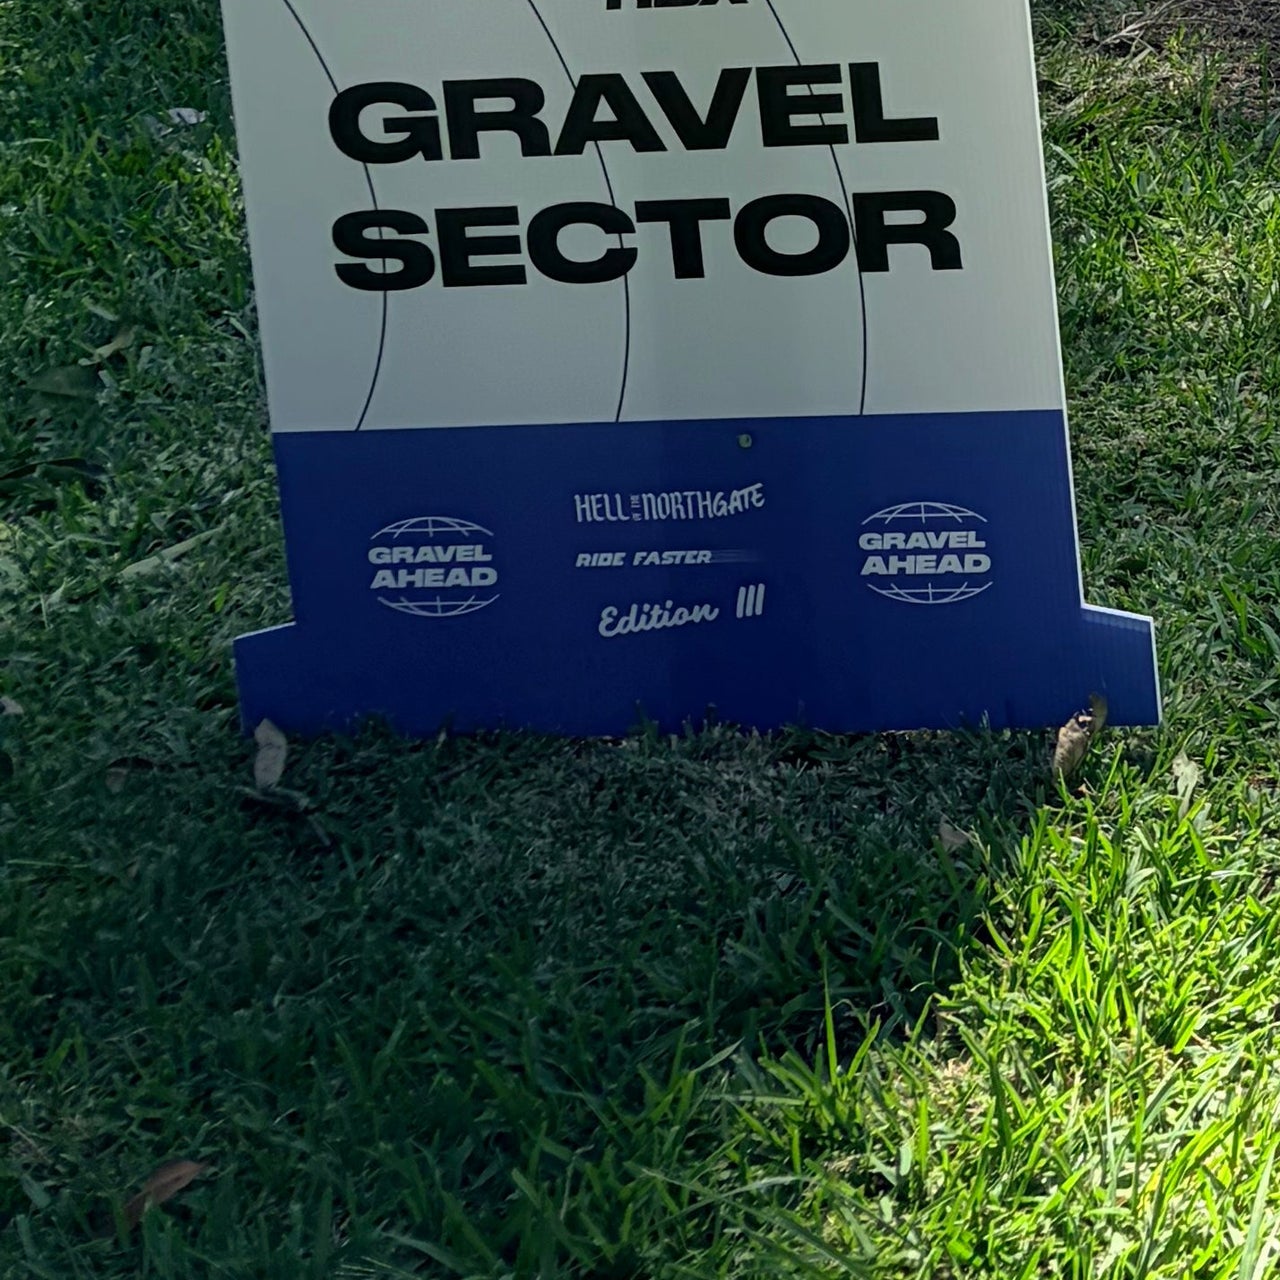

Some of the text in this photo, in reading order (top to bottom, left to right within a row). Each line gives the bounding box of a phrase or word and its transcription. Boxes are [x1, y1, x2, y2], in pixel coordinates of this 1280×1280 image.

[328, 61, 940, 165] GRAVEL
[331, 190, 963, 292] SECTOR
[574, 493, 630, 523] HELL
[641, 483, 766, 521] NORTHGATE
[858, 530, 986, 550] GRAVEL
[367, 544, 493, 564] GRAVEL
[575, 550, 713, 567] RIDE FASTER
[860, 553, 991, 576] AHEAD
[369, 567, 498, 589] AHEAD
[598, 600, 720, 638] Edition
